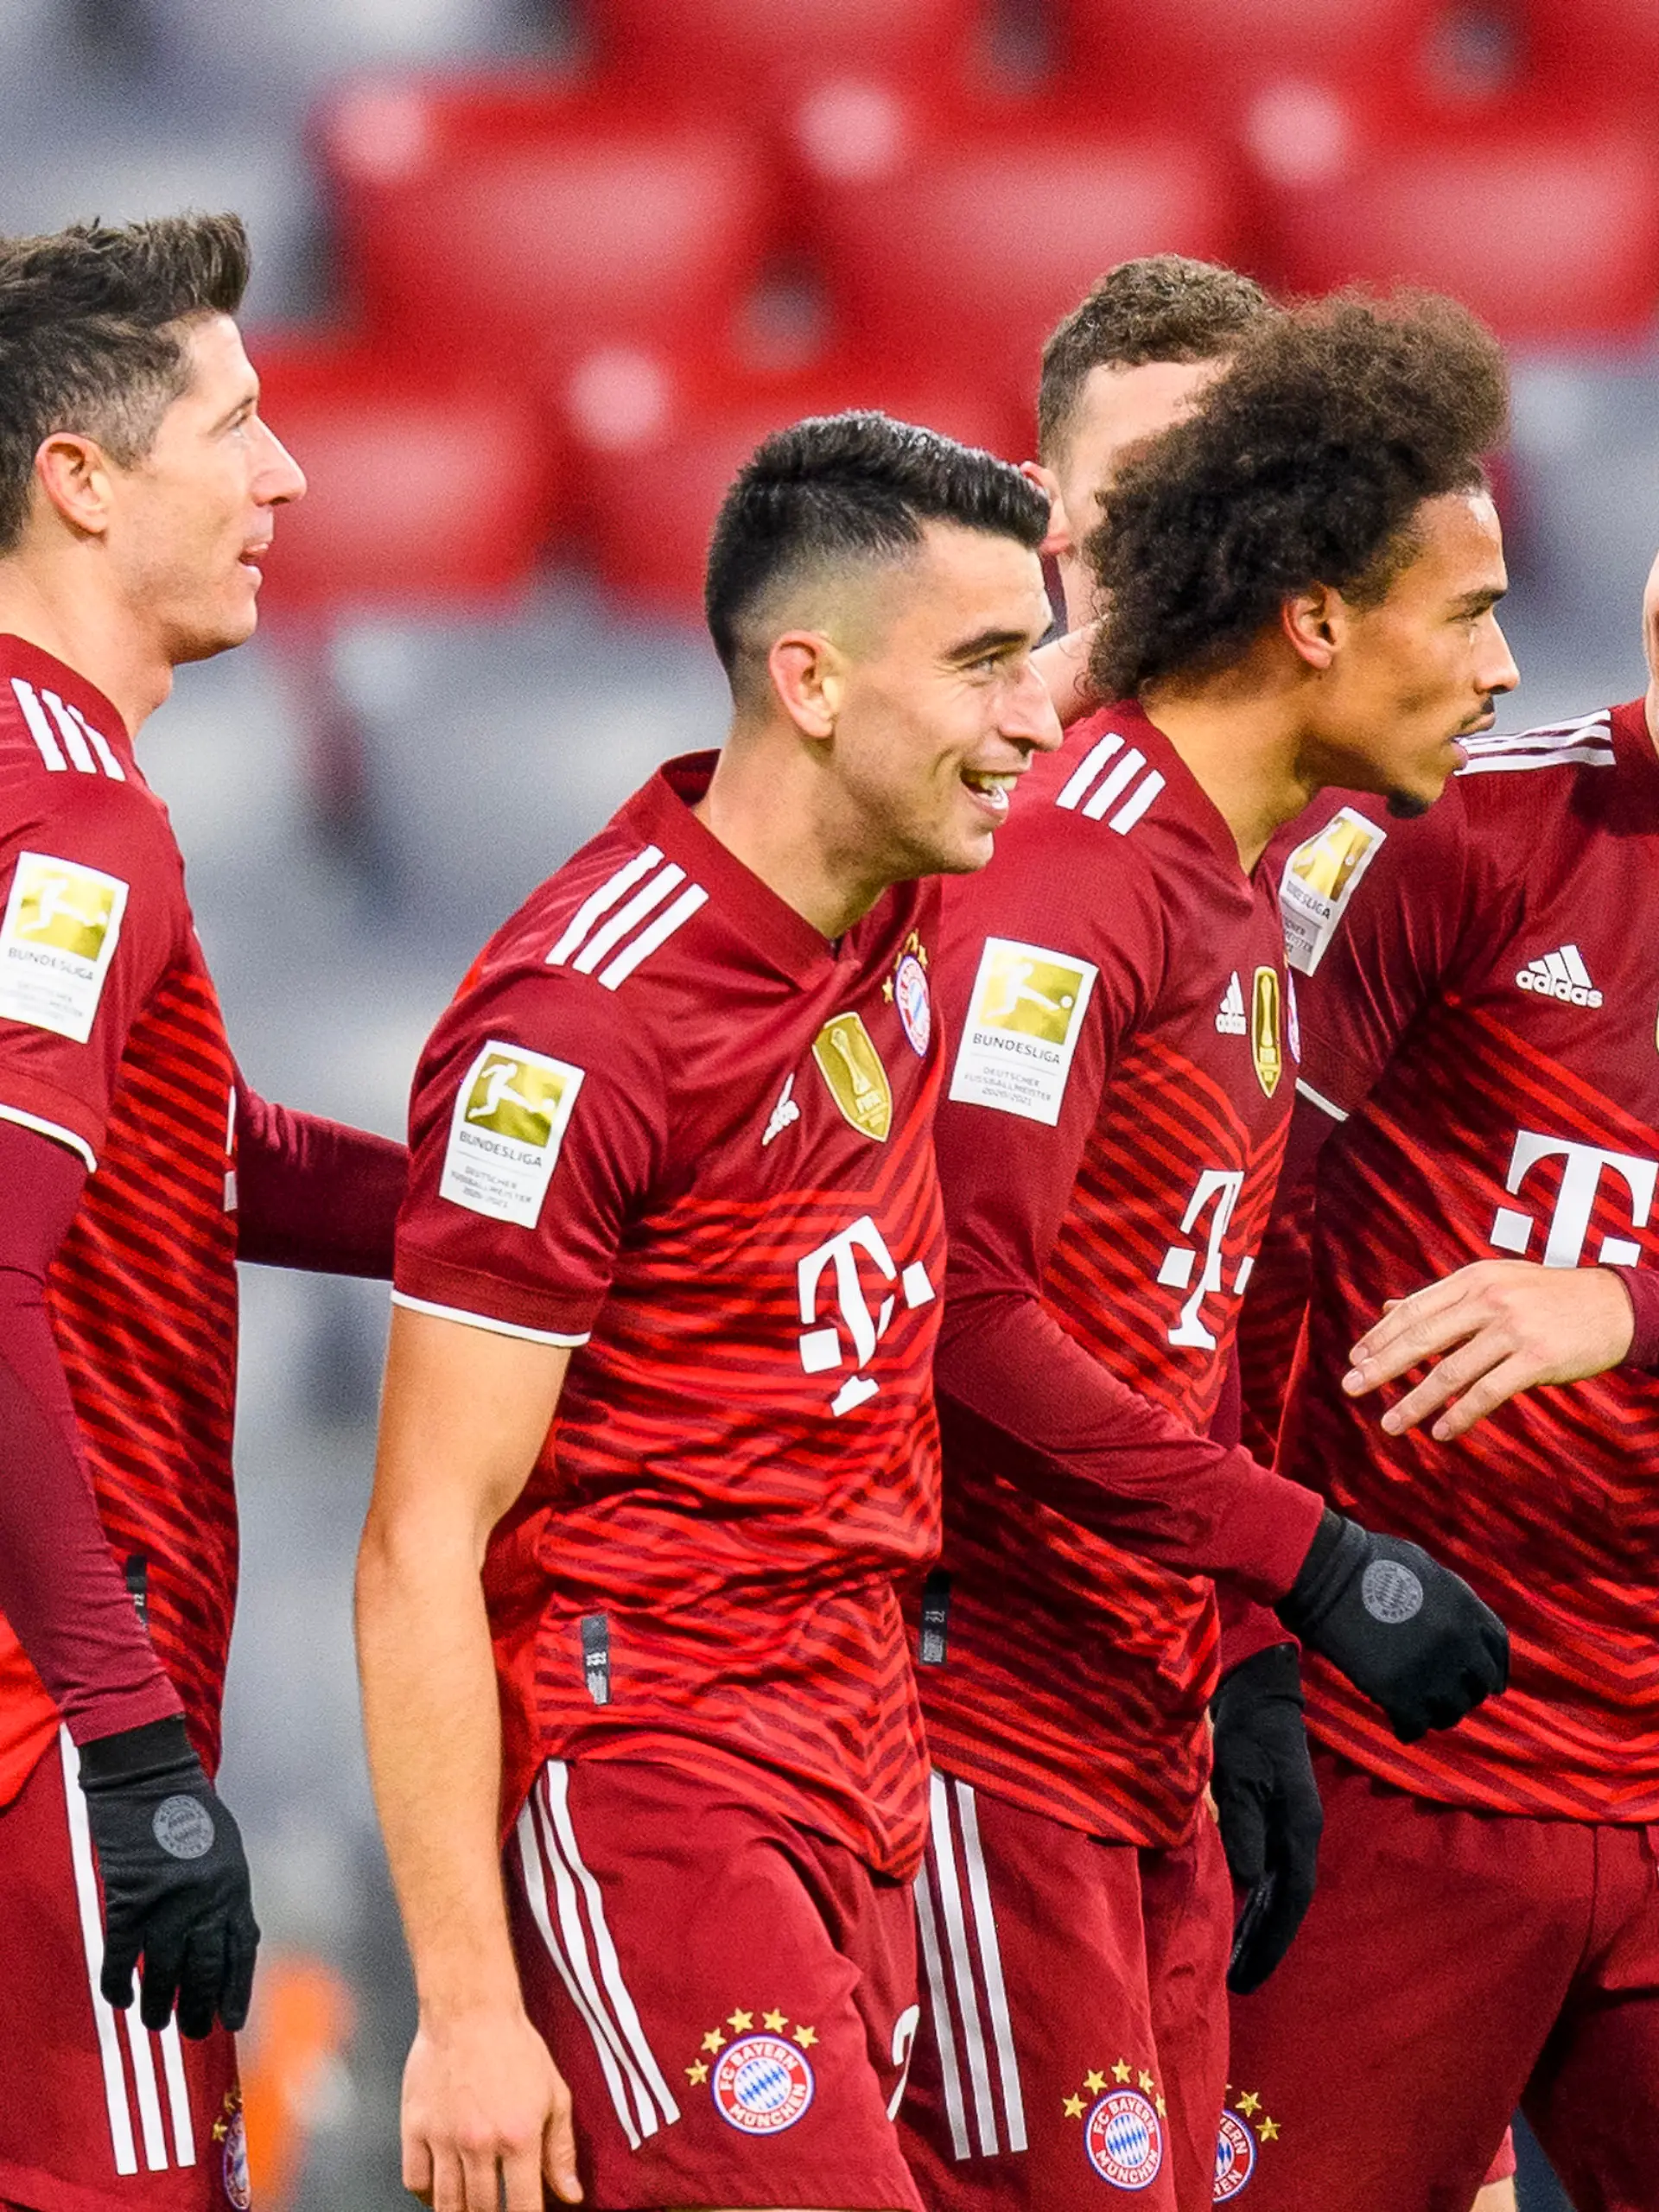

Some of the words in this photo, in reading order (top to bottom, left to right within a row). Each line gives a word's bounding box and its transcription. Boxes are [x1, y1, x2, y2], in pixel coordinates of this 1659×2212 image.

[1516, 966, 1603, 1008] adidas
[973, 1033, 1060, 1065] BUNDESLIGA
[460, 1130, 542, 1166] BUNDESLIGA
[729, 2043, 799, 2070] BAYERN
[1093, 2111, 1109, 2135] FC
[1108, 2098, 1155, 2134] BAYERN
